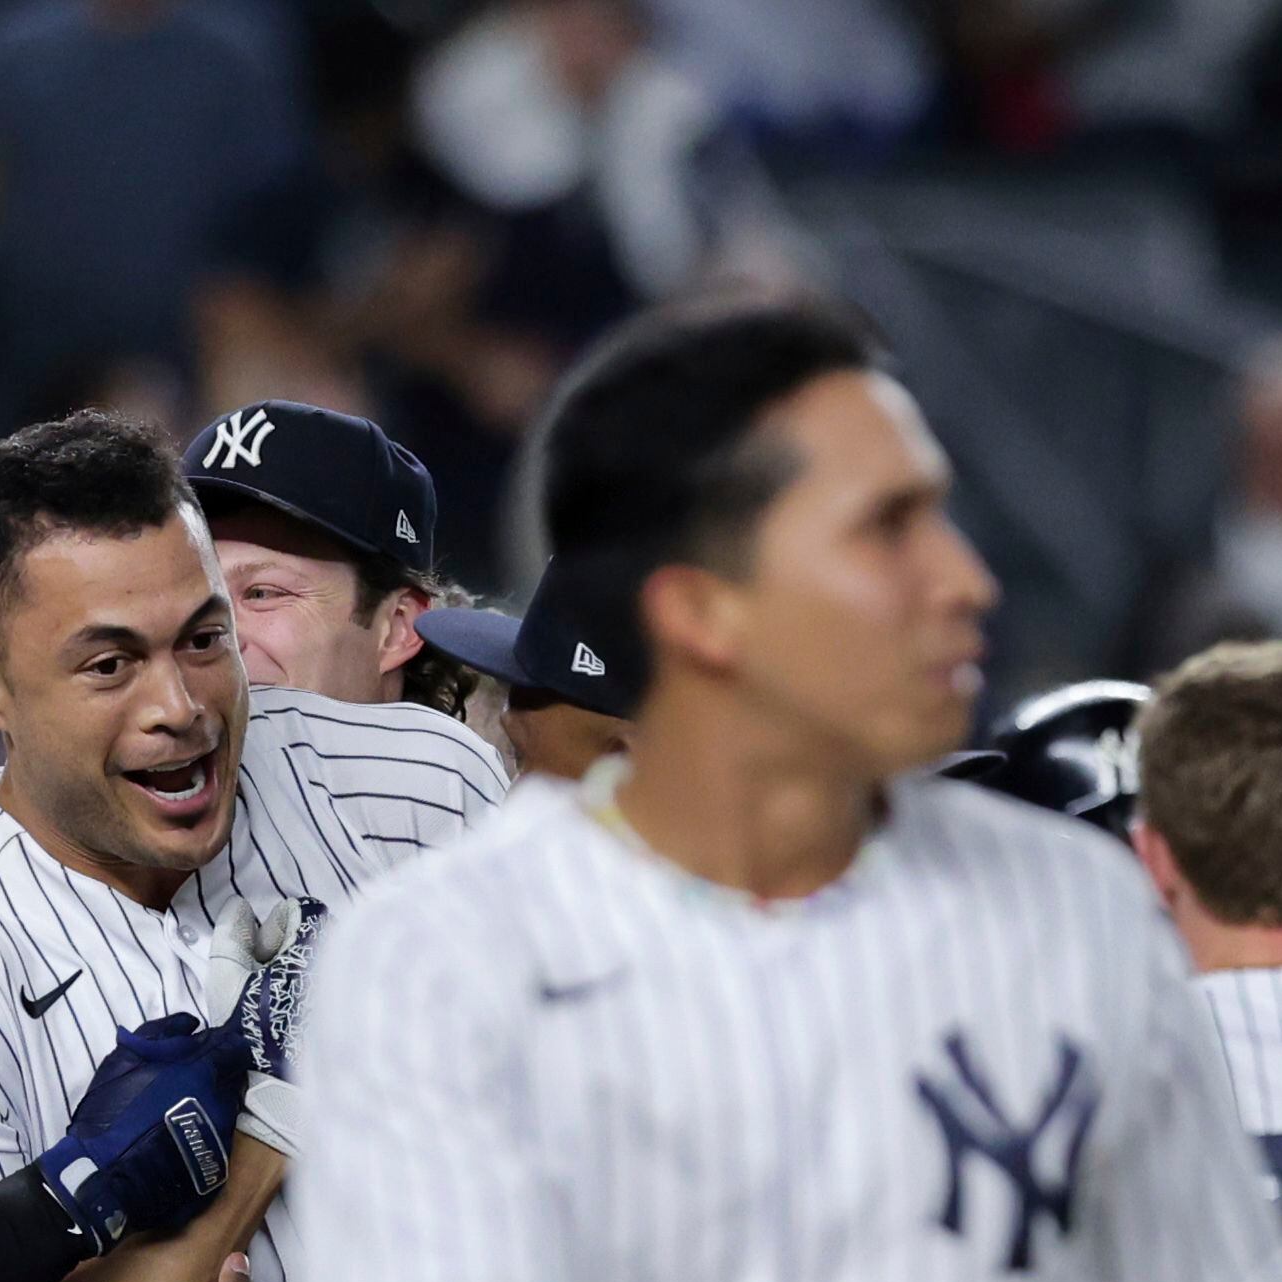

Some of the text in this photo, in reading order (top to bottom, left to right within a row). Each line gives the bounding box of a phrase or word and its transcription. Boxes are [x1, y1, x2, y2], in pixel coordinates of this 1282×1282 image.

[202, 408, 275, 469] NY
[171, 1111, 220, 1186] Franklin
[915, 1028, 1100, 1271] NY
